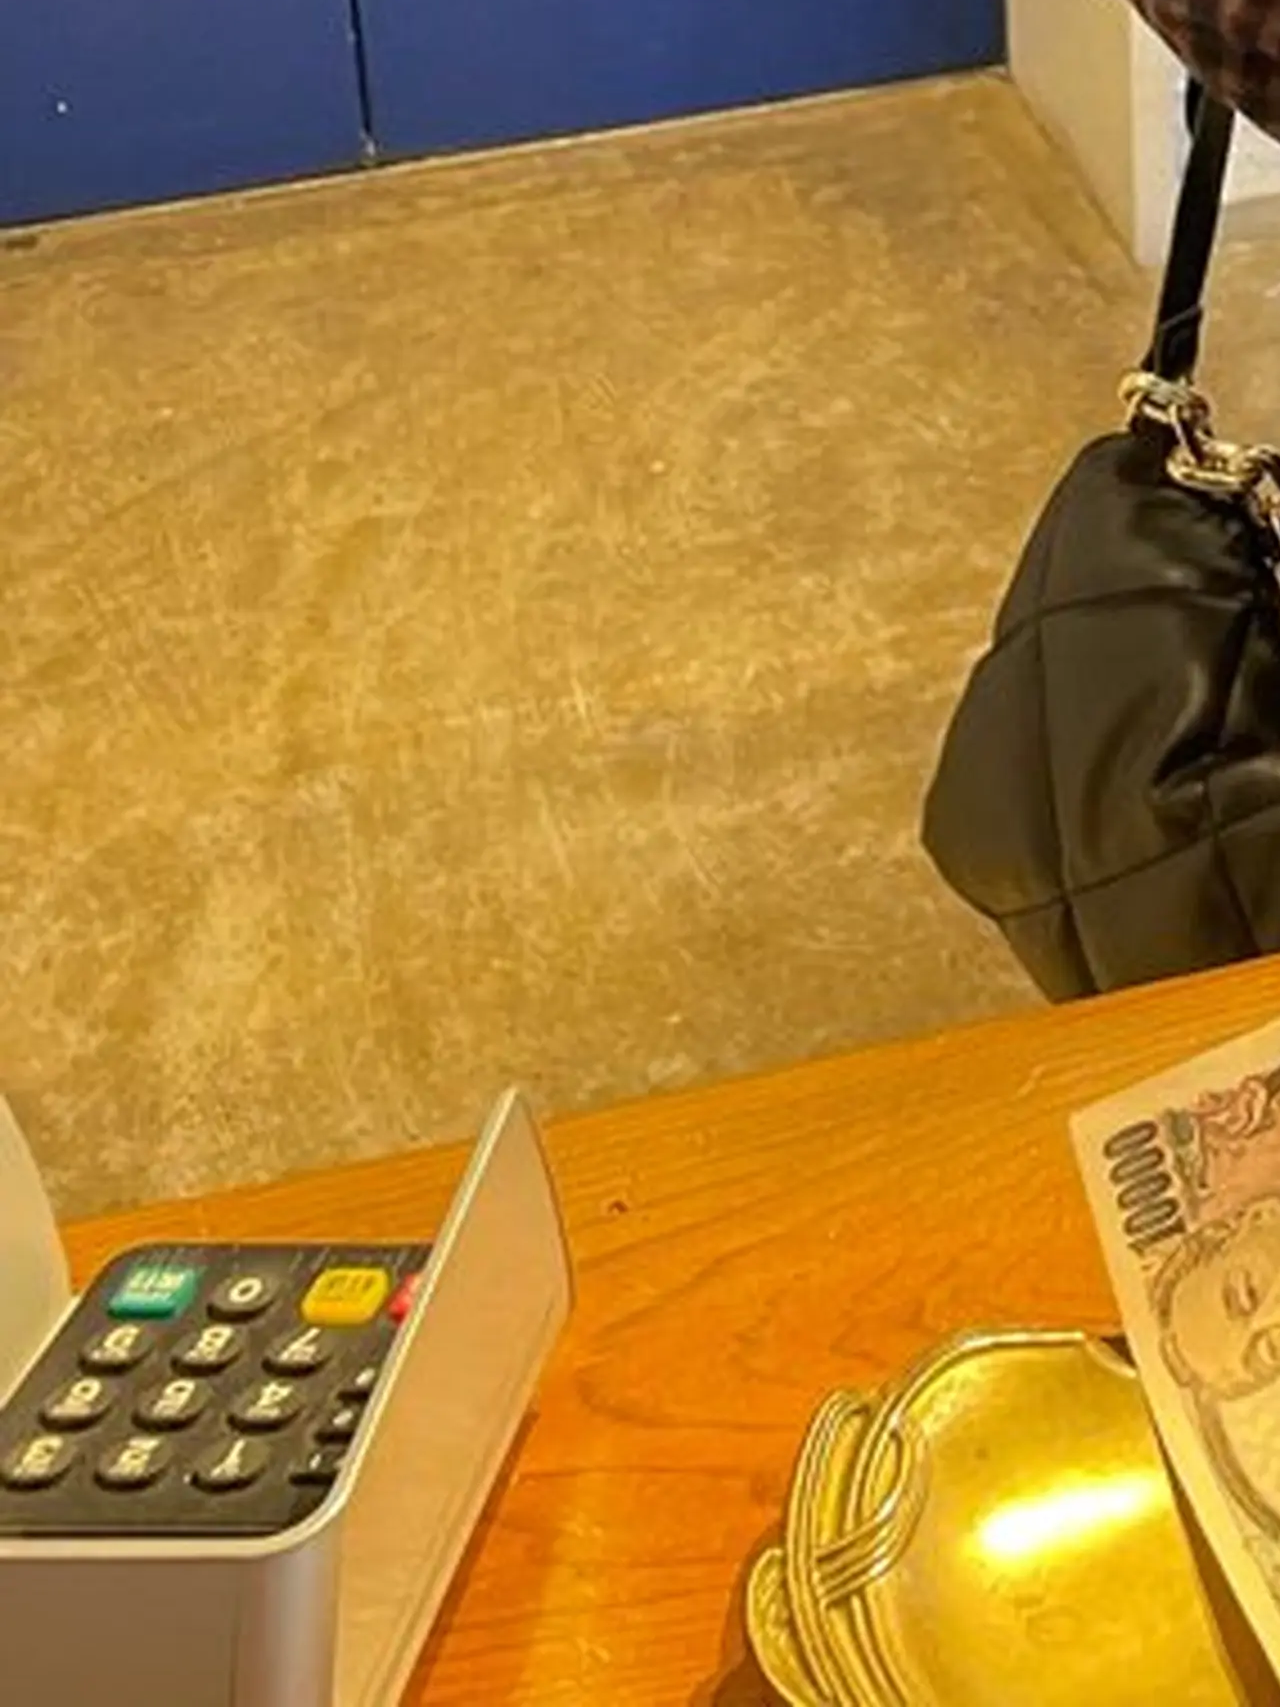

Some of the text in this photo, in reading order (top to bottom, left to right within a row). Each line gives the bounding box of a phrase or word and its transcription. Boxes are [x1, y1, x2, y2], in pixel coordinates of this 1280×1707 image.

[1103, 1120, 1187, 1259] 10000
[228, 1276, 264, 1304] 0
[287, 1327, 322, 1355] 7
[257, 1382, 294, 1410] 4
